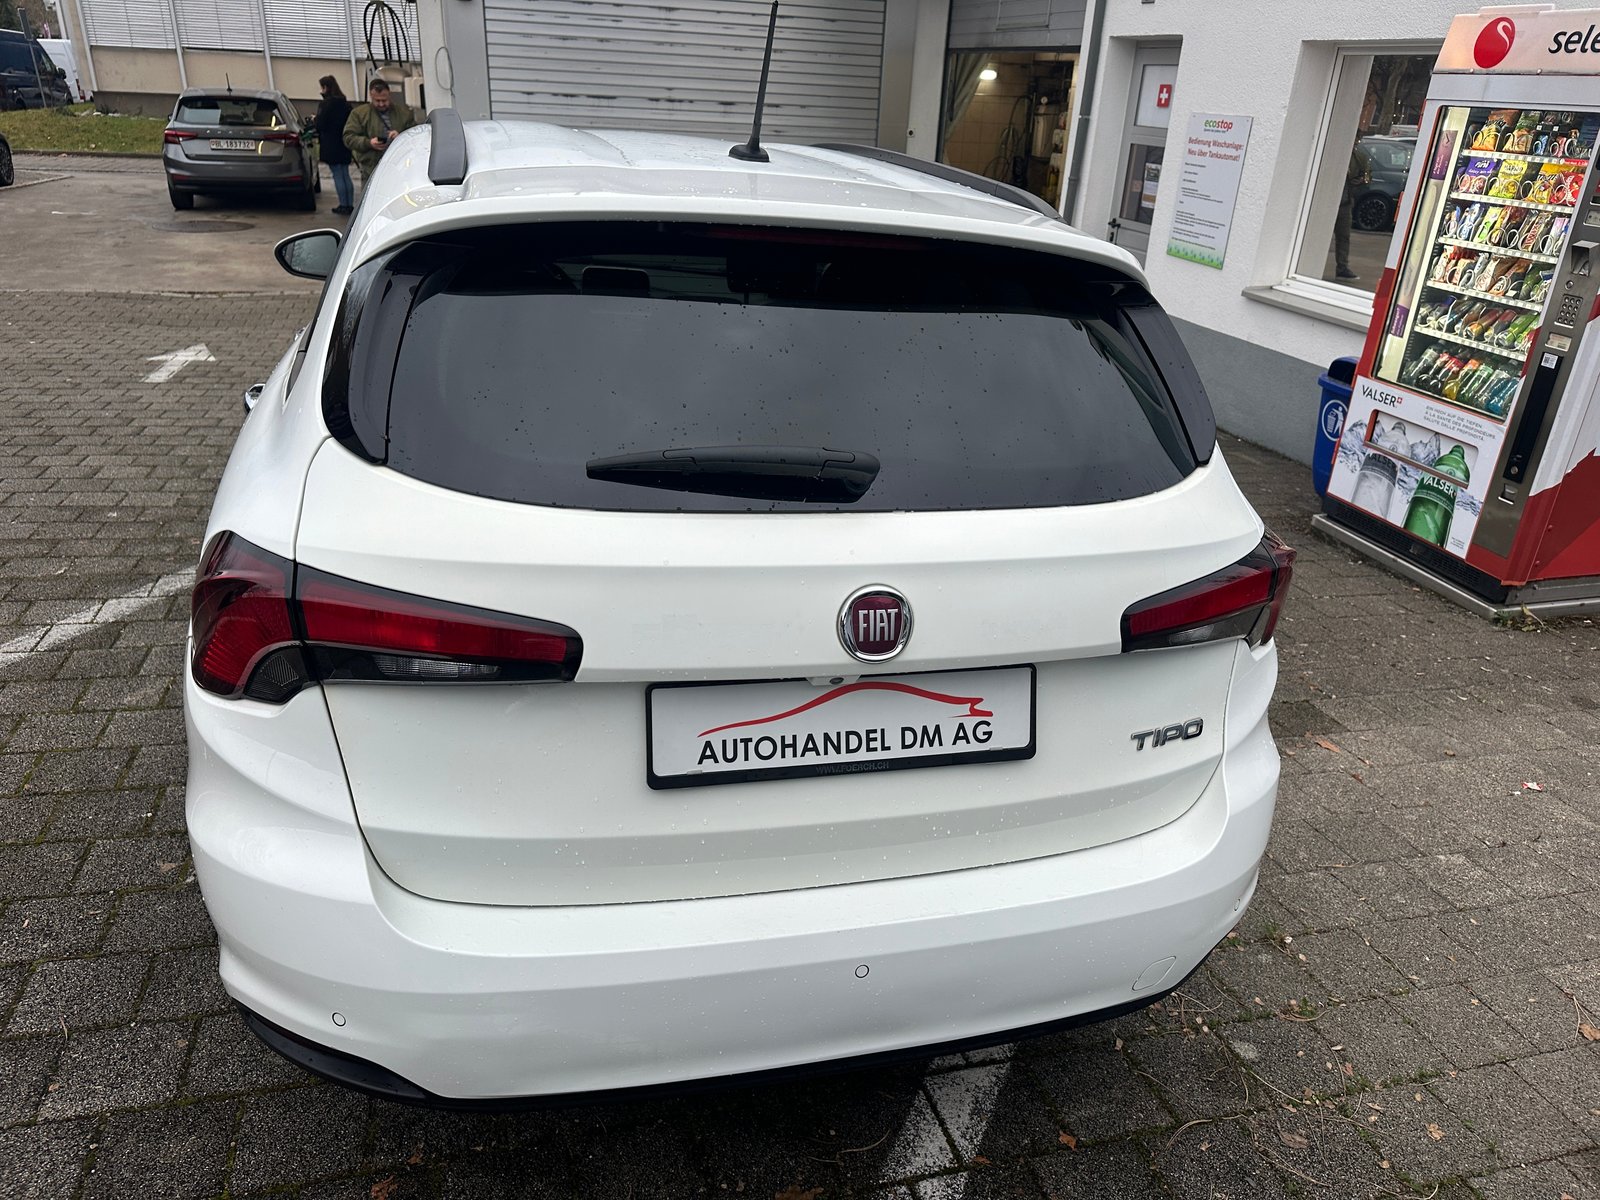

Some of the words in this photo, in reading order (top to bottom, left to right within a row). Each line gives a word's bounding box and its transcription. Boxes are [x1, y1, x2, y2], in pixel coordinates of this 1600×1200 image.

[1204, 119, 1233, 132] ecostop
[1187, 148, 1196, 156] Neu
[1197, 149, 1207, 157] über
[1188, 136, 1212, 148] Bedienung
[1212, 139, 1244, 151] Waschanlage:
[1362, 384, 1396, 408] VALSER
[1466, 419, 1482, 428] TIEFEN
[1422, 475, 1454, 498] VALSER
[858, 607, 900, 644] FIAT
[697, 727, 892, 765] AUTOHANDEL
[900, 724, 946, 750] DM
[952, 719, 993, 746] AG
[1130, 717, 1204, 752] TIPO
